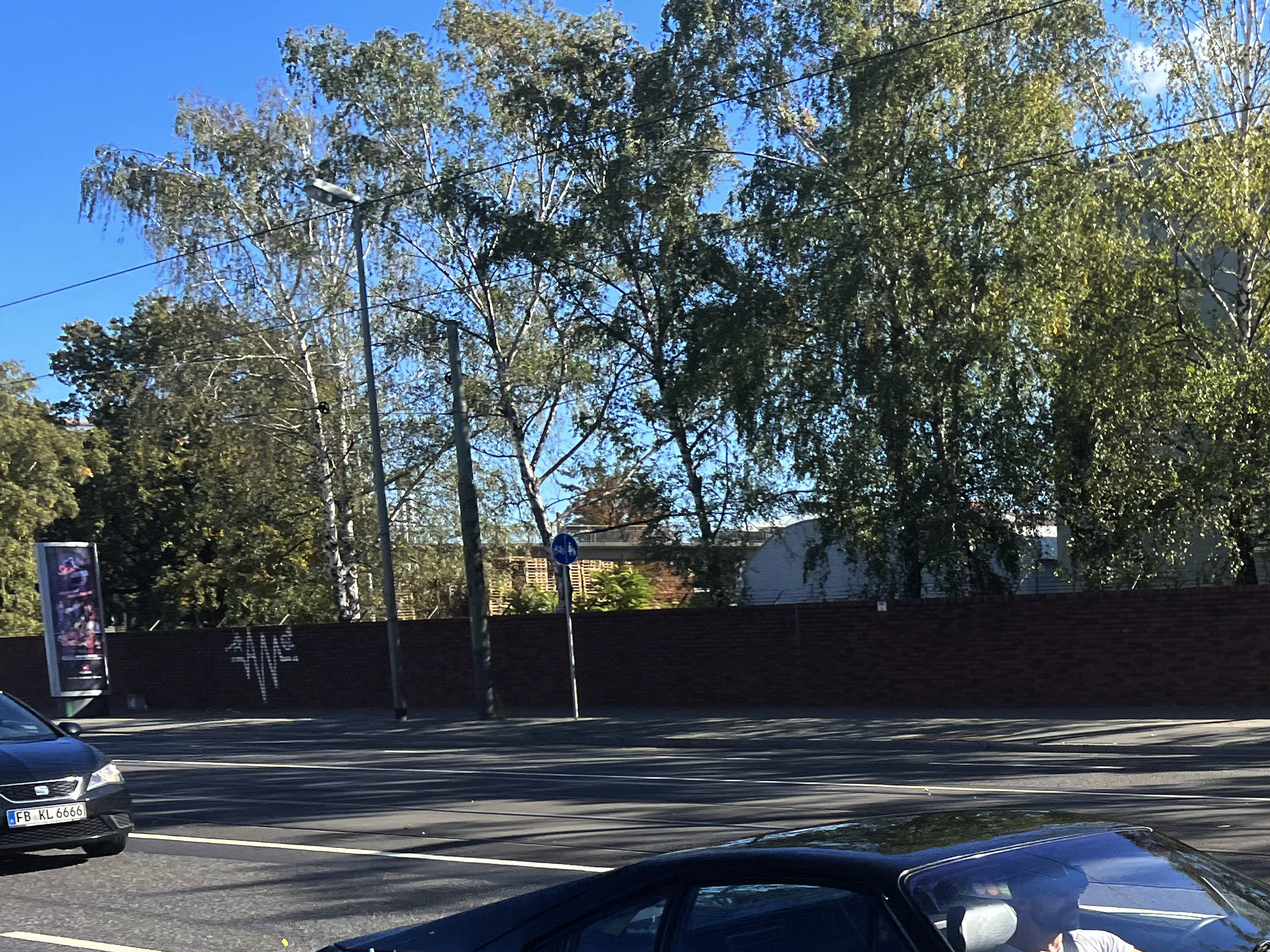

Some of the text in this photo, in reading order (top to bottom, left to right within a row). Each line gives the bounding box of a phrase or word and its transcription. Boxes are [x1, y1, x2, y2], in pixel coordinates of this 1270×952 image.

[16, 805, 83, 823] FB KL 6666
